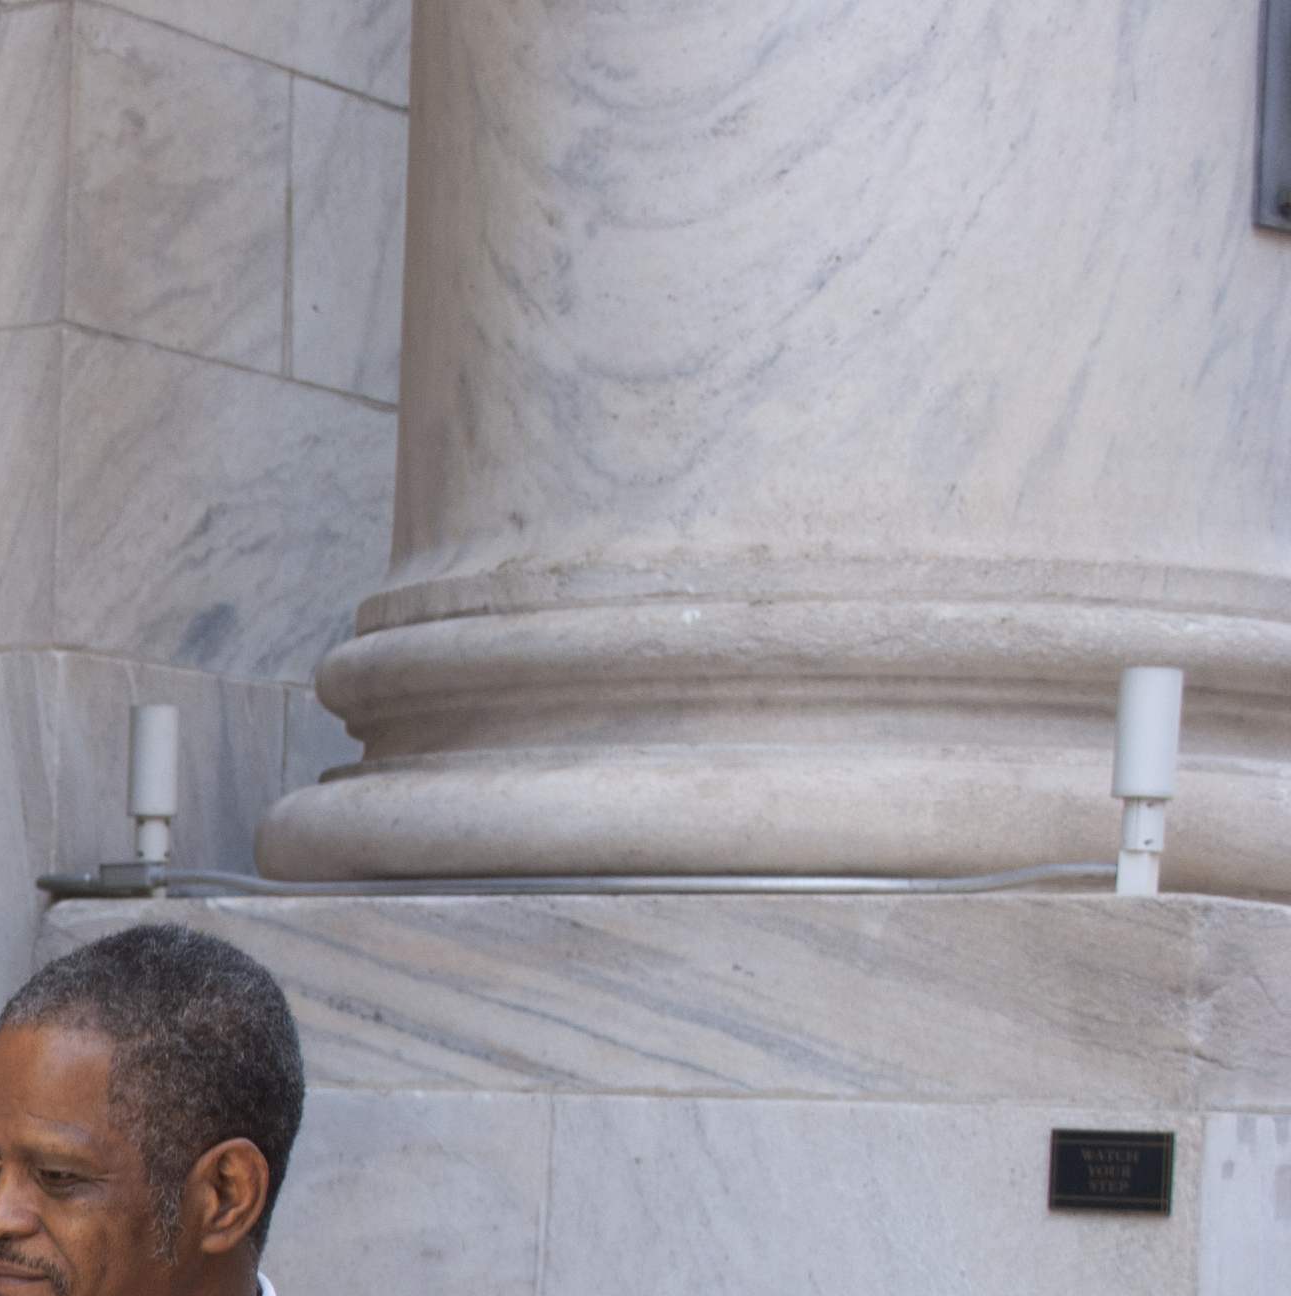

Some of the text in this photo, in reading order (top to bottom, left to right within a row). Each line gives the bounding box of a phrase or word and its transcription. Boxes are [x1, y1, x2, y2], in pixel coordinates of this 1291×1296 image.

[1080, 1148, 1140, 1163] WATCH
[1087, 1163, 1132, 1178] YOUR
[1088, 1179, 1130, 1193] STEP
